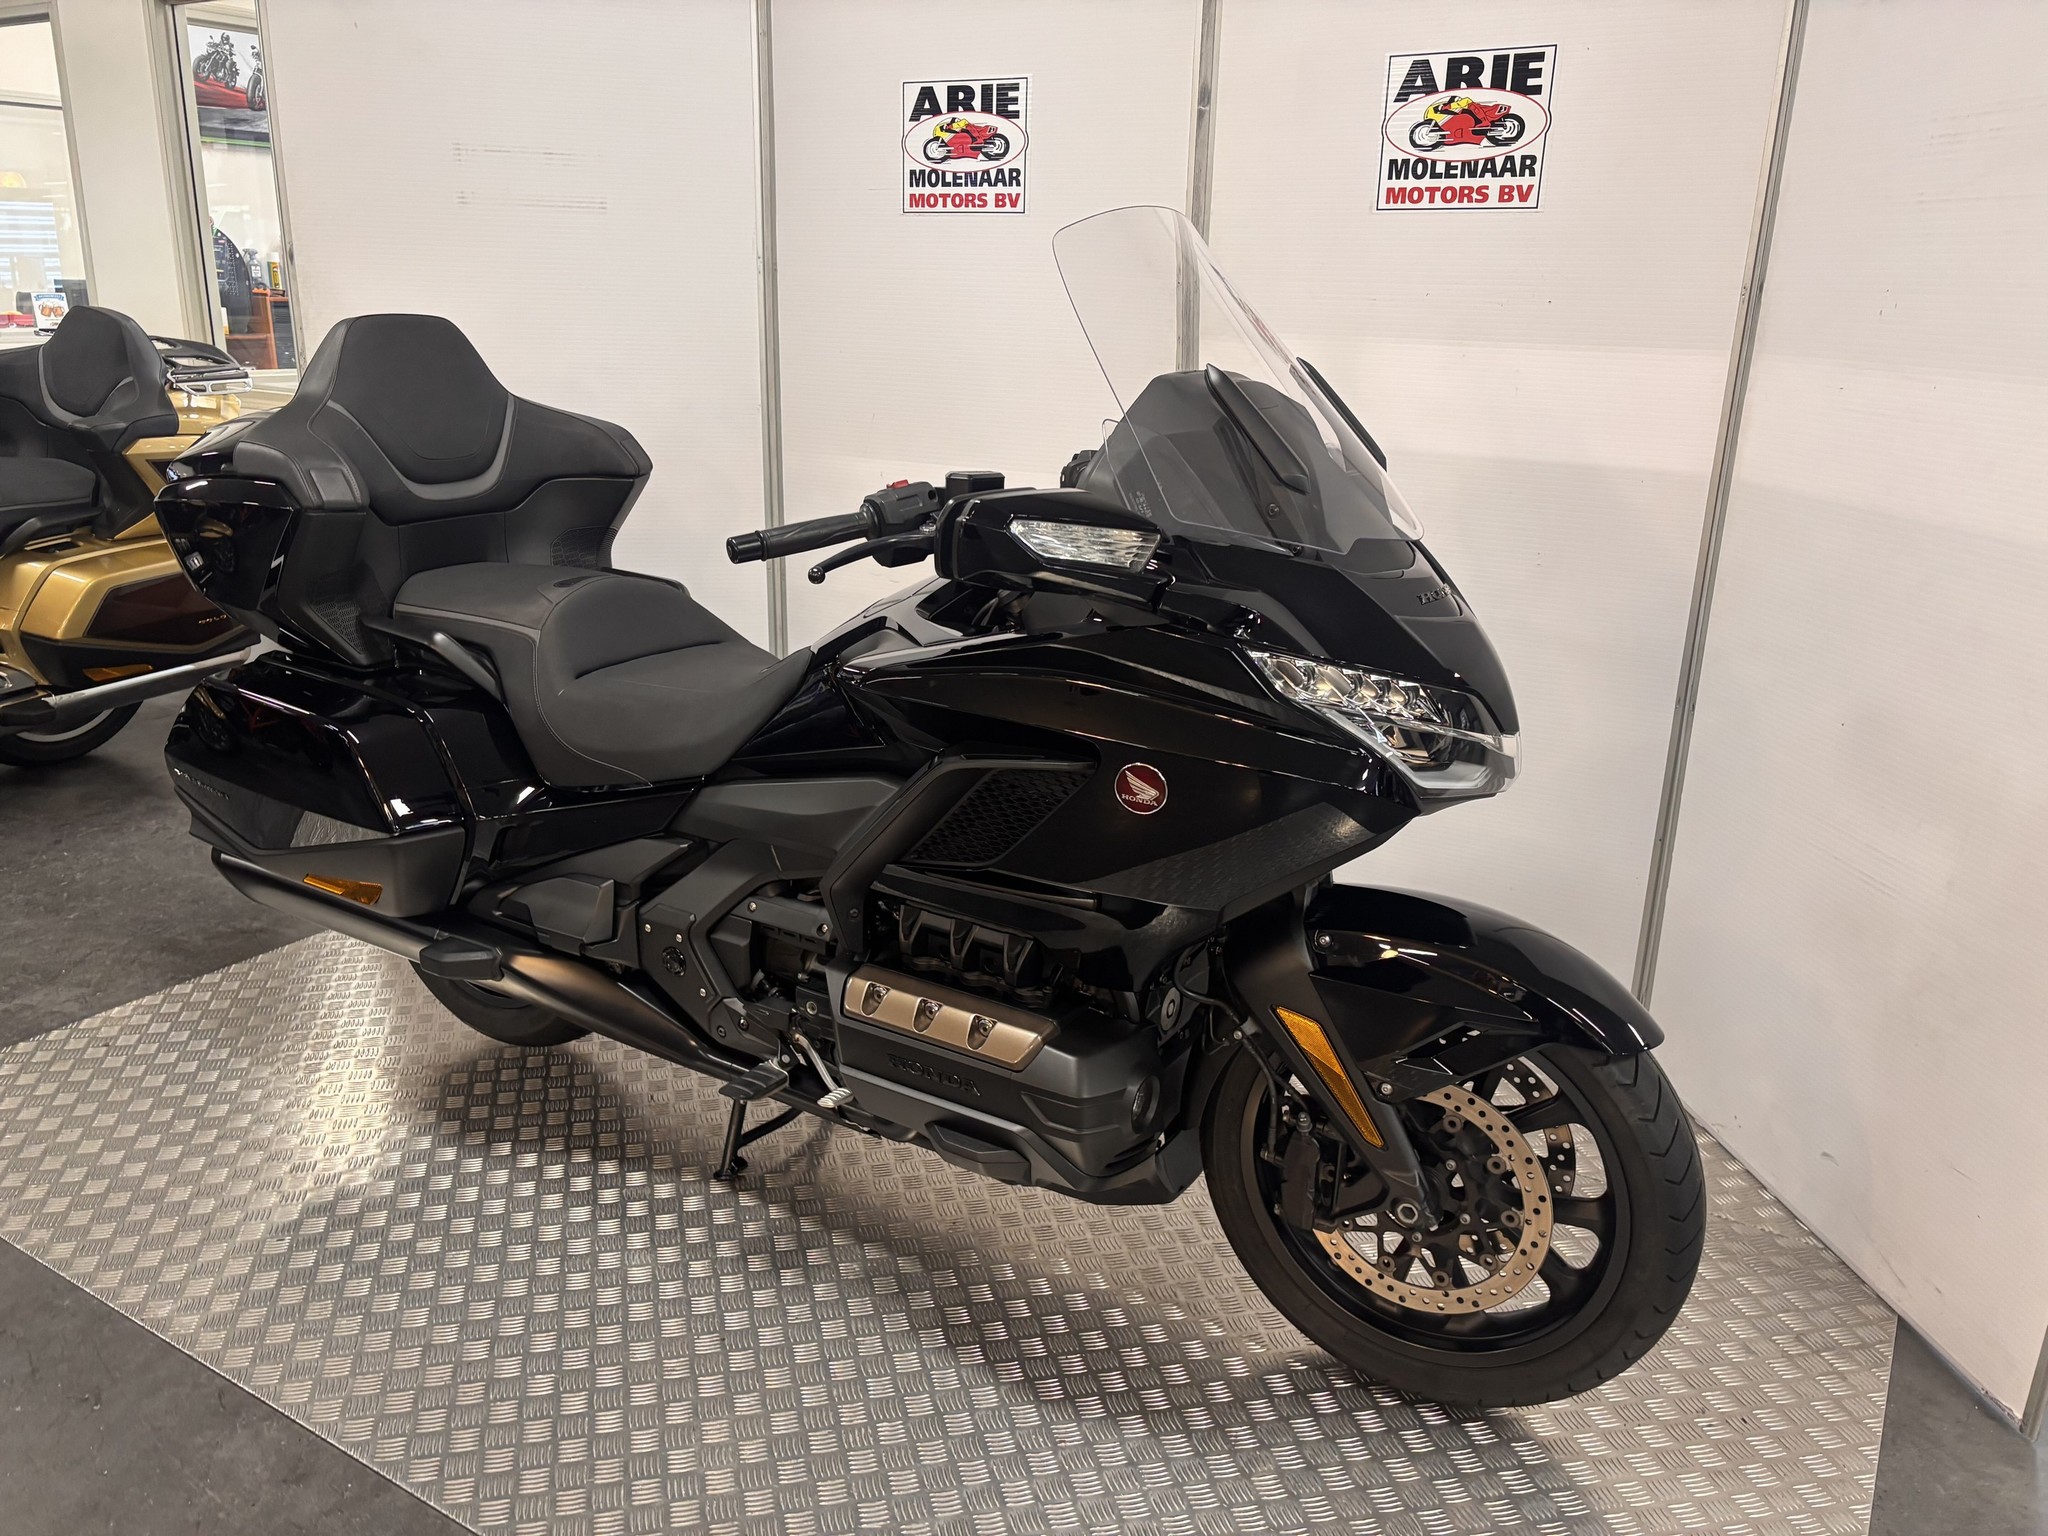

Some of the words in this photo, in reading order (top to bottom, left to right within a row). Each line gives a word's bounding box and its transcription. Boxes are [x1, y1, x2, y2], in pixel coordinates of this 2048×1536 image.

[1393, 51, 1546, 103] ARIE
[908, 82, 1020, 122] ARIE
[909, 168, 1021, 187] MOLENAAR
[1387, 154, 1538, 180] MOLENAAR
[909, 192, 988, 208] MOTORS
[994, 192, 1021, 208] BV
[1385, 185, 1490, 205] MOTORS
[1497, 184, 1535, 203] BV
[1121, 793, 1158, 807] HONDA
